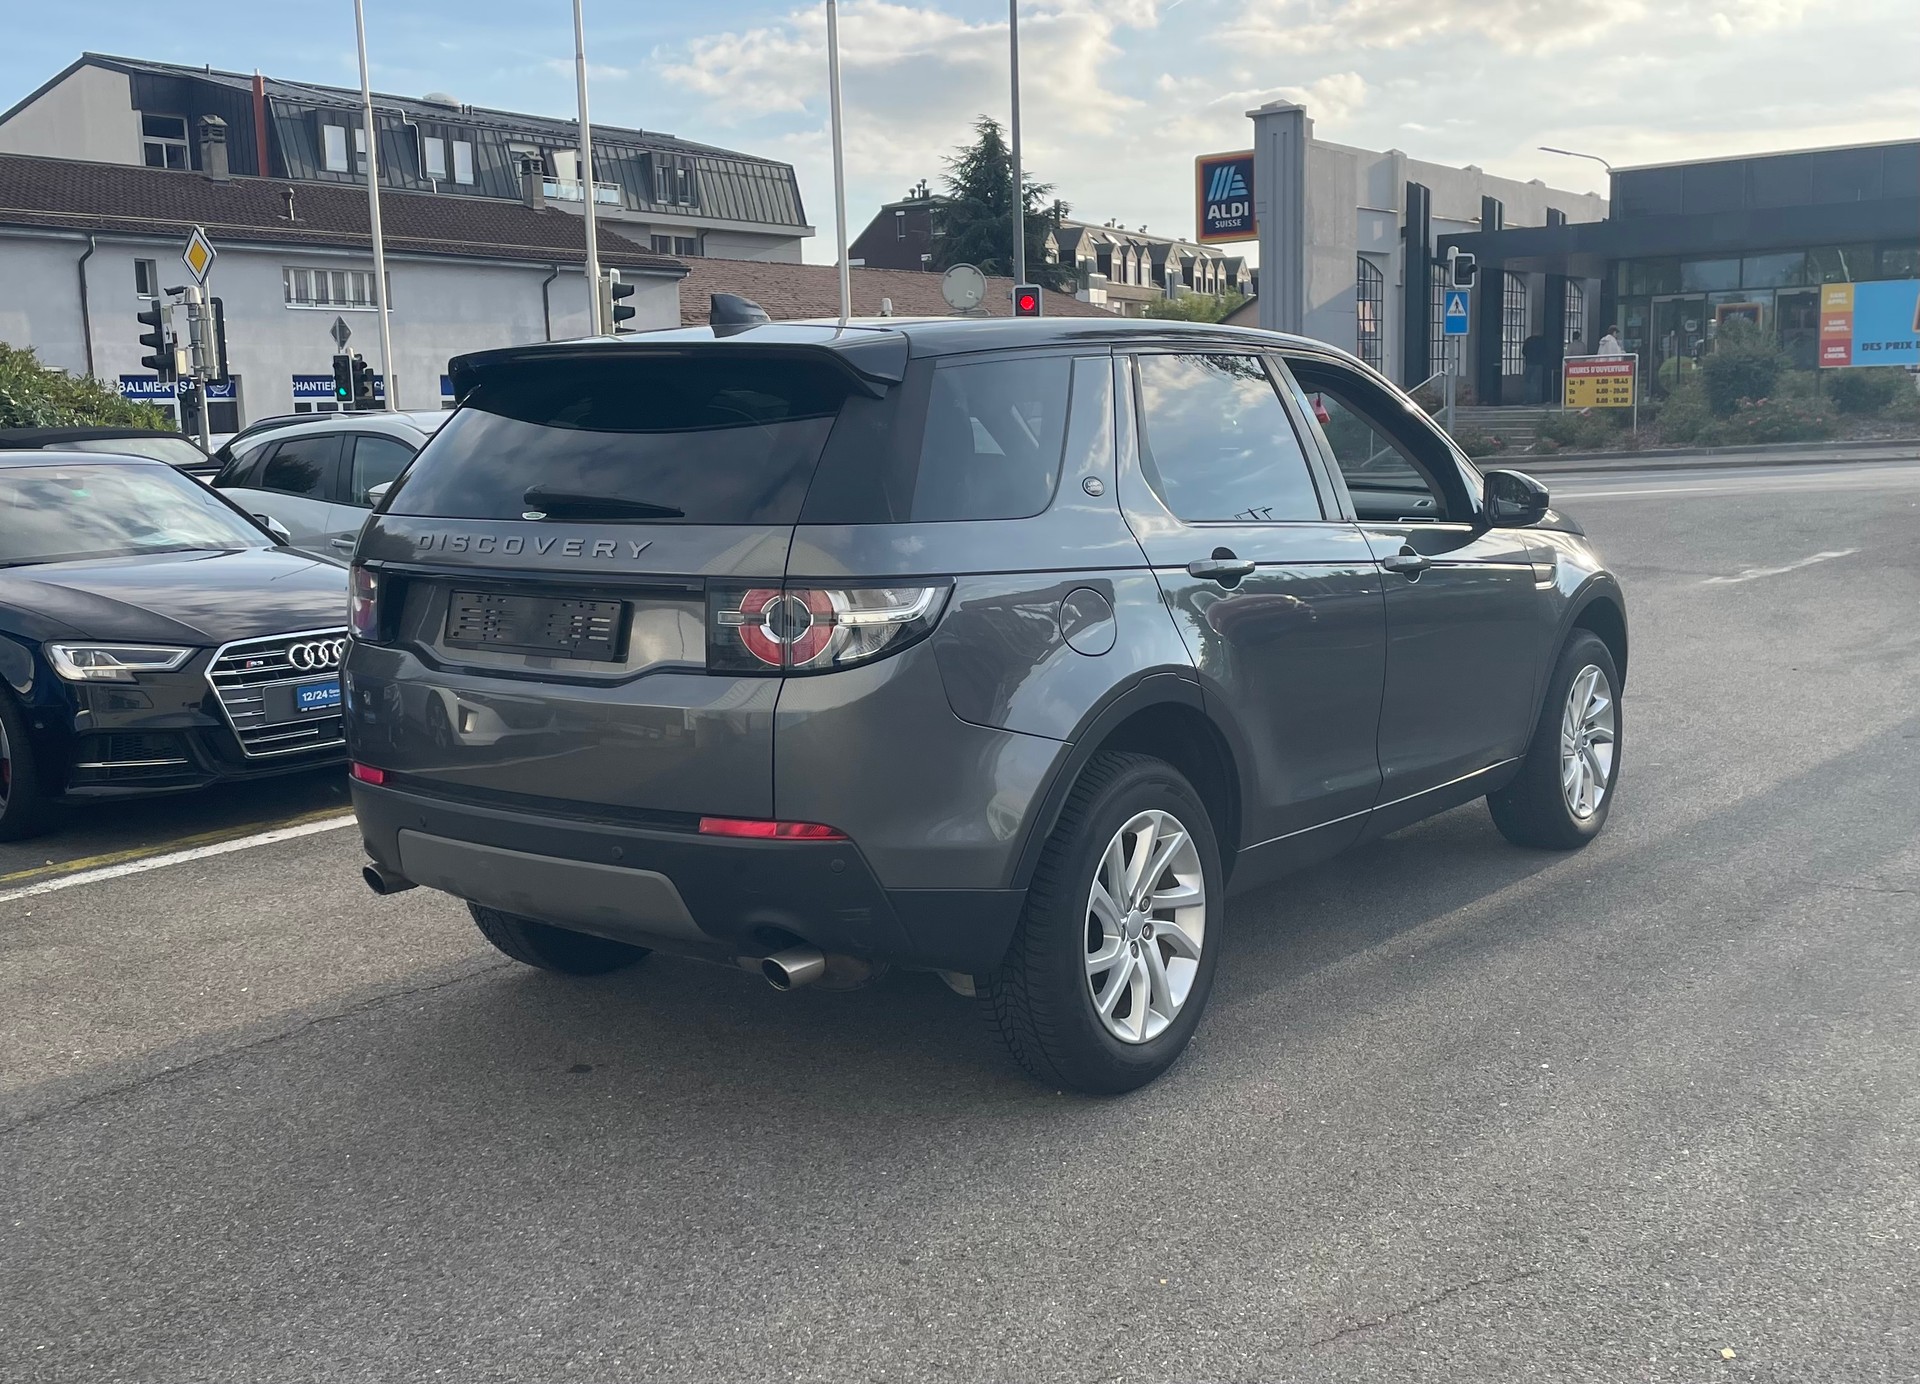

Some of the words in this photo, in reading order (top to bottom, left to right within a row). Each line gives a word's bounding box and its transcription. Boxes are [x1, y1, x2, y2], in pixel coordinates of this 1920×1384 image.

[1207, 201, 1249, 220] ALDI
[1215, 219, 1242, 228] SUISSE
[1862, 342, 1882, 351] DES
[1885, 341, 1912, 350] PRIX
[1569, 366, 1590, 374] HEURES
[1590, 365, 1630, 373] D'OUVERTURE
[118, 381, 171, 393] BALMER
[416, 533, 653, 559] DISCOVERY
[302, 690, 328, 701] 12/24
